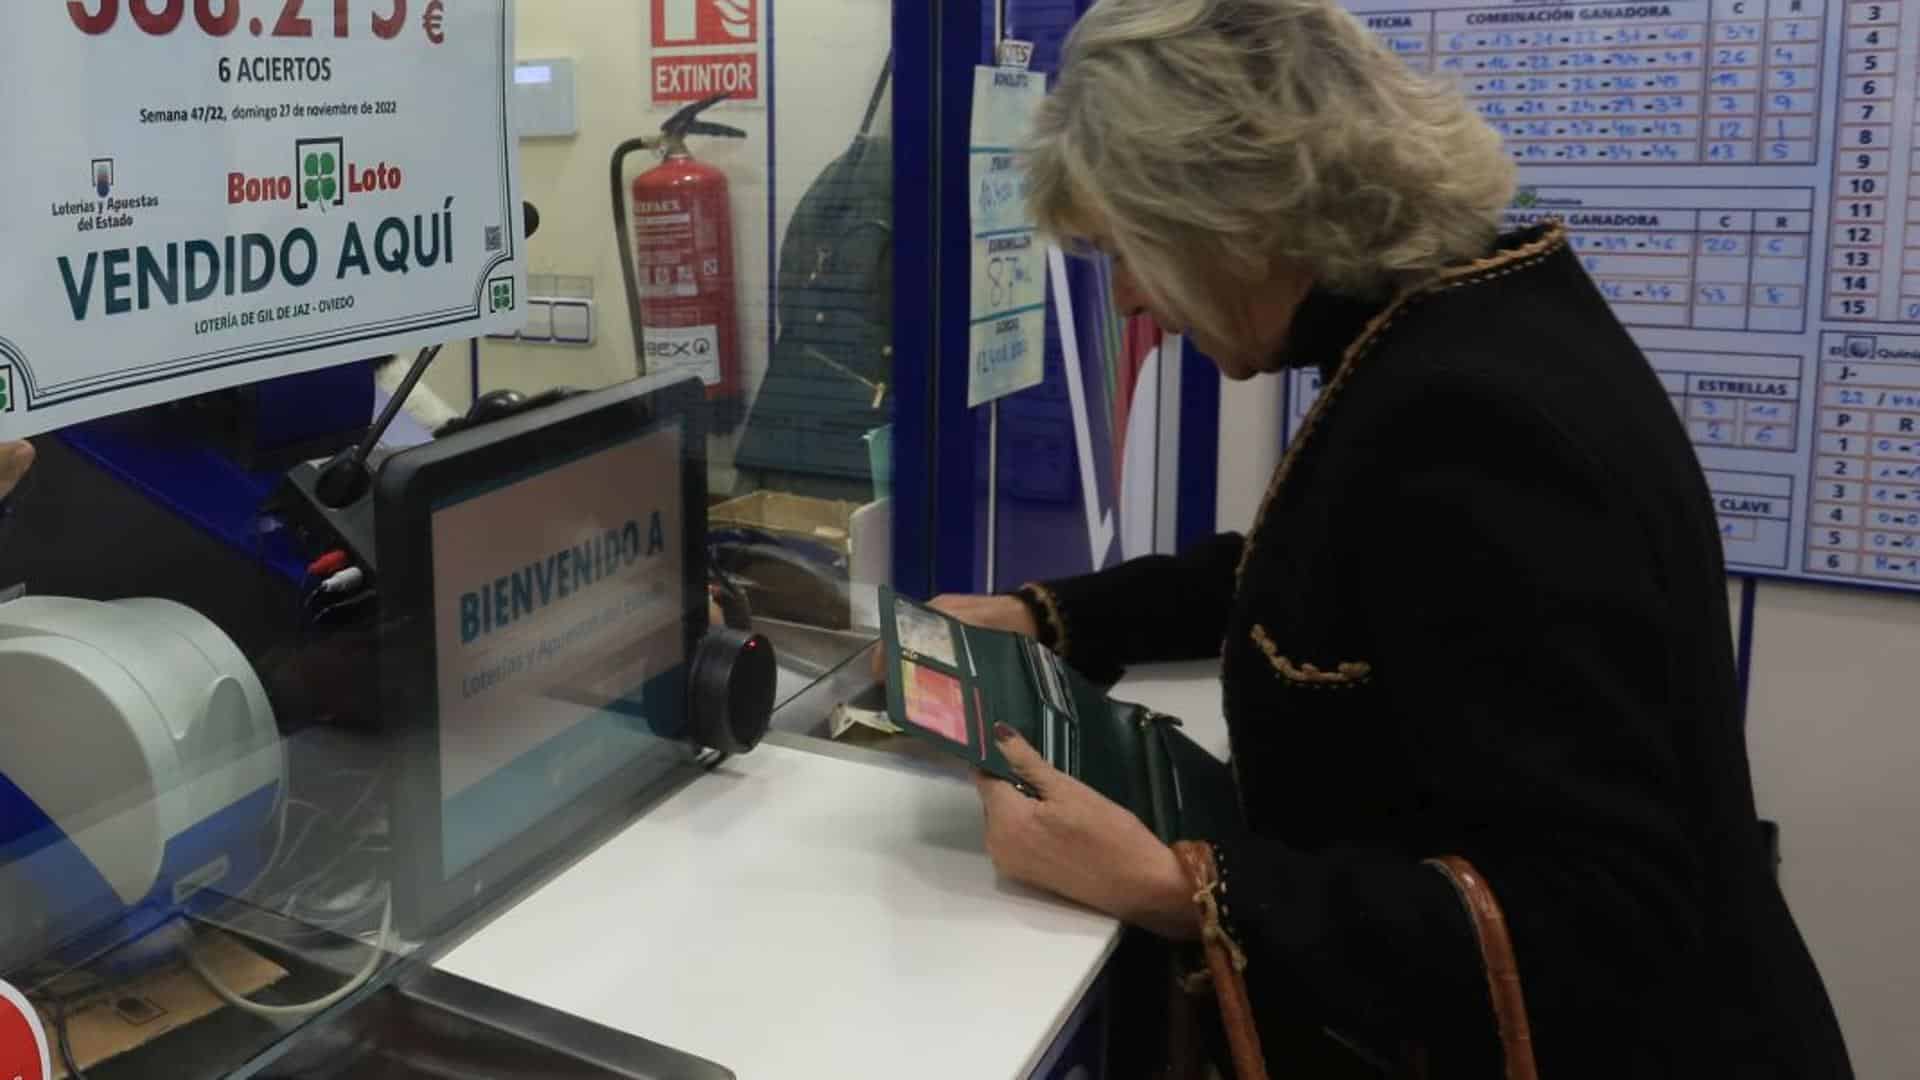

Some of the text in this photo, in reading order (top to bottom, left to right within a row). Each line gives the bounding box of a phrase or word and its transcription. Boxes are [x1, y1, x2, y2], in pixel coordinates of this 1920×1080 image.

[1466, 5, 1672, 26] COMBINACIÓN GANADORA
[1732, 2, 1745, 14] C
[1868, 5, 1882, 21] 3
[1367, 16, 1412, 28] FECHA
[1866, 31, 1880, 45] 4
[218, 56, 332, 82] 6 ACIERTOS
[1864, 55, 1878, 71] 5
[656, 62, 753, 93] EXTINTOR
[1862, 80, 1877, 96] 6
[139, 107, 188, 124] Semana
[190, 105, 228, 122] 47/22,
[231, 104, 278, 121] domingo
[293, 103, 305, 117] de
[306, 101, 358, 117] noviembre
[360, 101, 373, 115] de
[374, 101, 396, 114] 2022
[1861, 105, 1875, 120] 7
[1859, 130, 1873, 145] 8
[1856, 154, 1871, 169] 9
[228, 162, 401, 204] Bono Loto
[1851, 179, 1875, 194] 10
[107, 194, 159, 212] Apuestas
[1849, 204, 1873, 218] 11
[77, 215, 133, 231] del Estado
[1569, 214, 1661, 227] GANADORA
[1719, 216, 1731, 228] C
[1776, 216, 1788, 229] R
[1847, 228, 1871, 243] 12
[57, 196, 453, 321] VENDIDO AQUÍ
[1845, 252, 1869, 268] 13
[1843, 276, 1868, 292] 14
[194, 312, 238, 335] LOTERÍA
[241, 311, 255, 328] DE
[257, 307, 275, 325] GIL
[277, 305, 291, 321] DE
[293, 302, 311, 318] JAZ
[318, 295, 355, 315] OVIEDO
[1841, 300, 1867, 315] 15
[1698, 380, 1787, 396] ESTRELLAS
[1837, 414, 1851, 427] P
[1900, 418, 1914, 431] R
[1839, 438, 1848, 452] 1
[1834, 461, 1847, 476] 2
[1832, 485, 1845, 498] 3
[1720, 498, 1771, 514] CLAVE
[1829, 508, 1843, 522] 4
[1828, 531, 1842, 545] 5
[1826, 555, 1840, 569] 6
[460, 509, 664, 645] BIENVENIDO A
